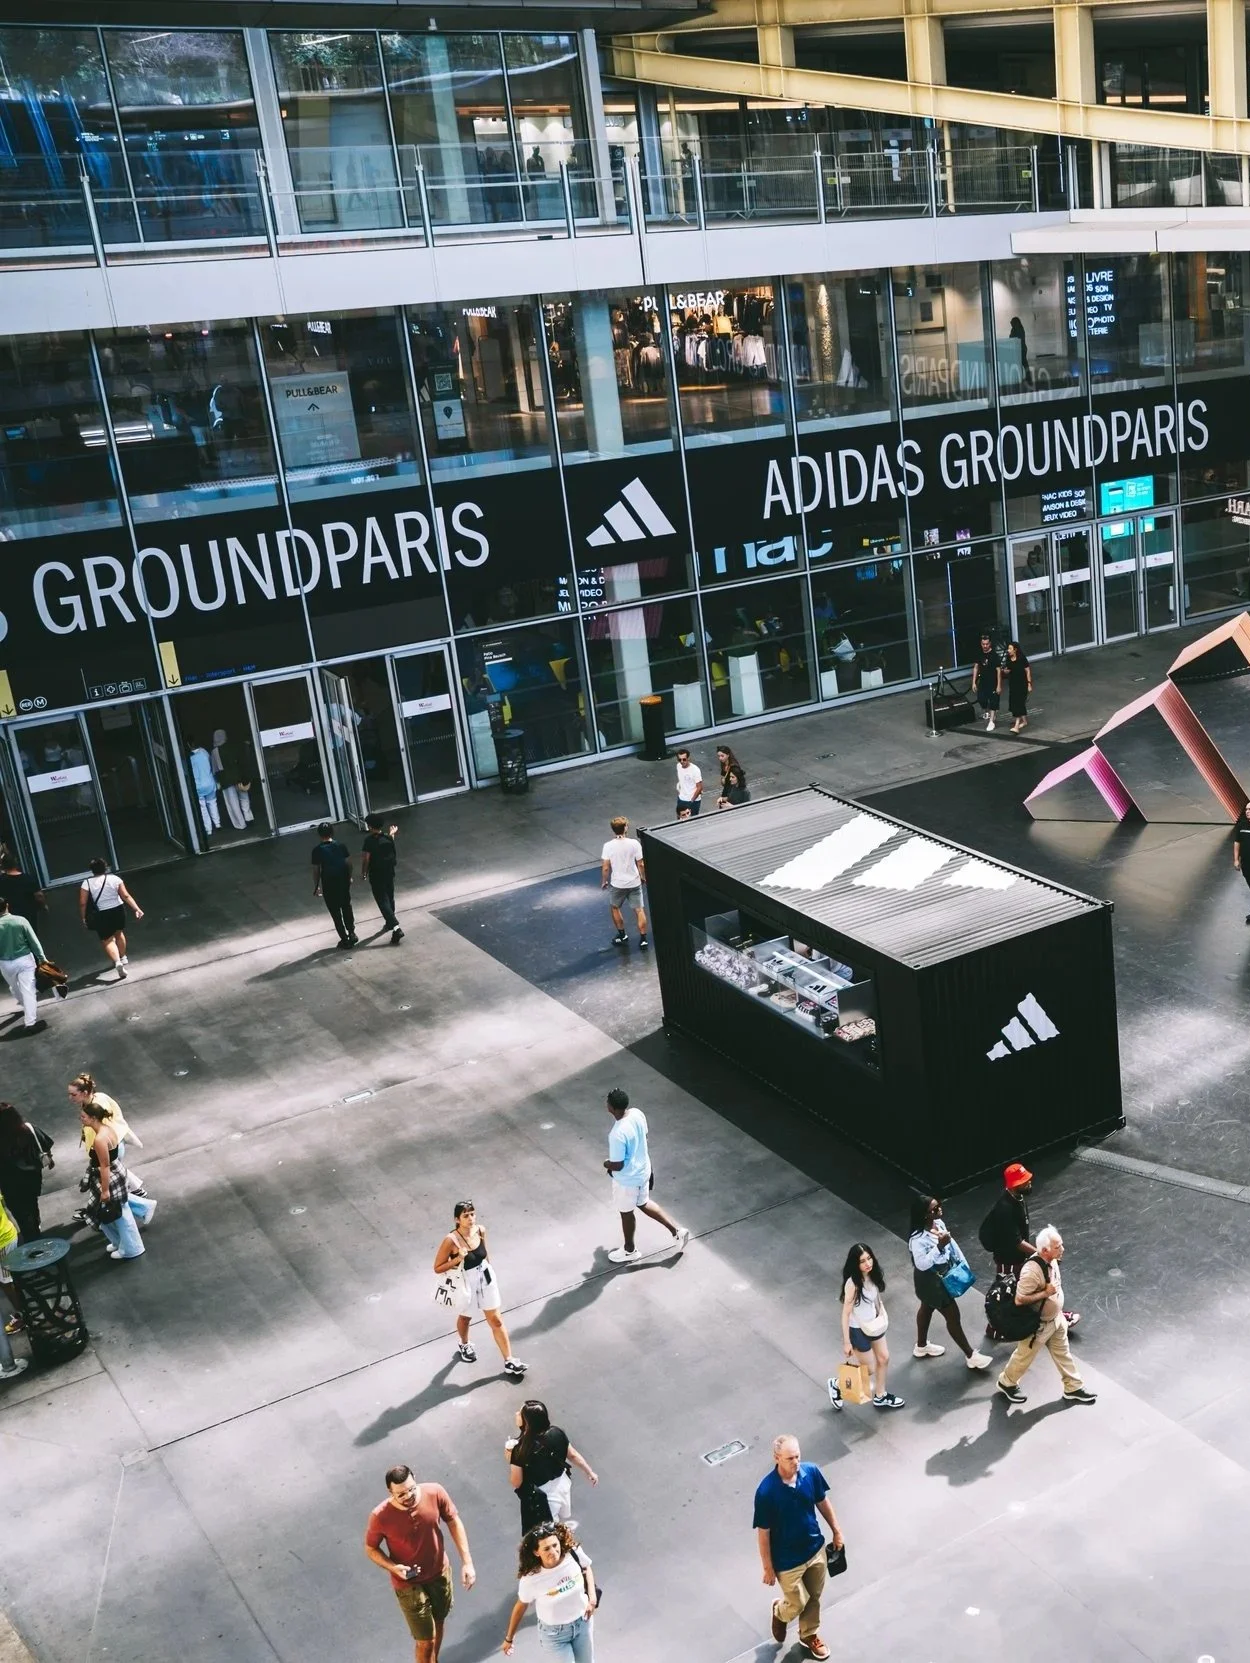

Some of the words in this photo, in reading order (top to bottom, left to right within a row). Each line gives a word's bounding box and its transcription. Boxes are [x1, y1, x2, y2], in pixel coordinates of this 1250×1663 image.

[1086, 270, 1113, 283] LIVRE
[1095, 285, 1109, 293] SON
[1092, 294, 1114, 302] DESIGN
[1094, 315, 1115, 323] PHOTO
[286, 385, 338, 399] PULL&BEAR
[763, 439, 925, 519] ADIDAS
[940, 399, 1209, 489] GROUNDPARIS
[1058, 490, 1072, 498] KIDS
[1059, 510, 1077, 519] VIDEO
[33, 502, 490, 635] GROUNDPARIS
[591, 577, 597, 585] &
